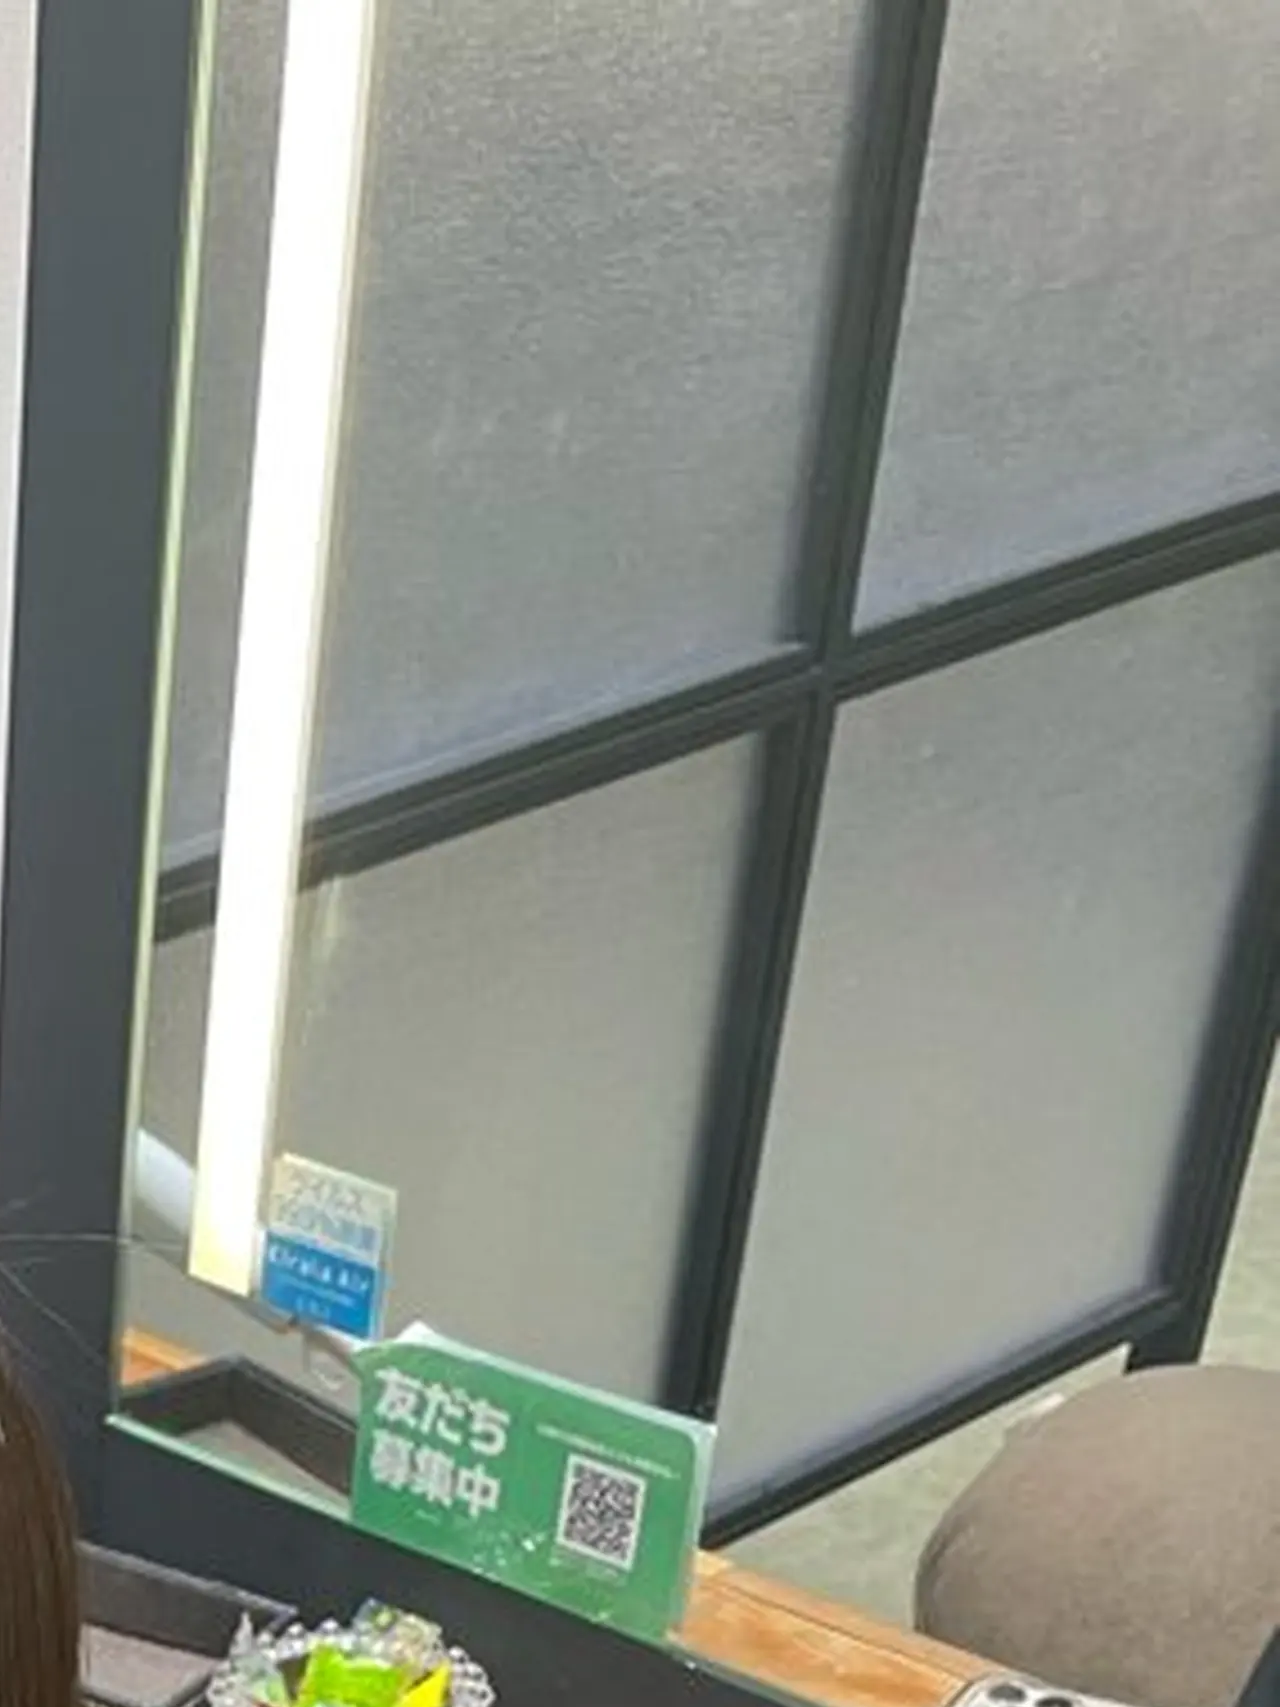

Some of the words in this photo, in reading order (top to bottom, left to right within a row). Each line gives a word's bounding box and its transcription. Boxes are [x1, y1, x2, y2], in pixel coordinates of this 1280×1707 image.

[373, 1366, 511, 1457] 友だち
[369, 1428, 501, 1520] 募集中
